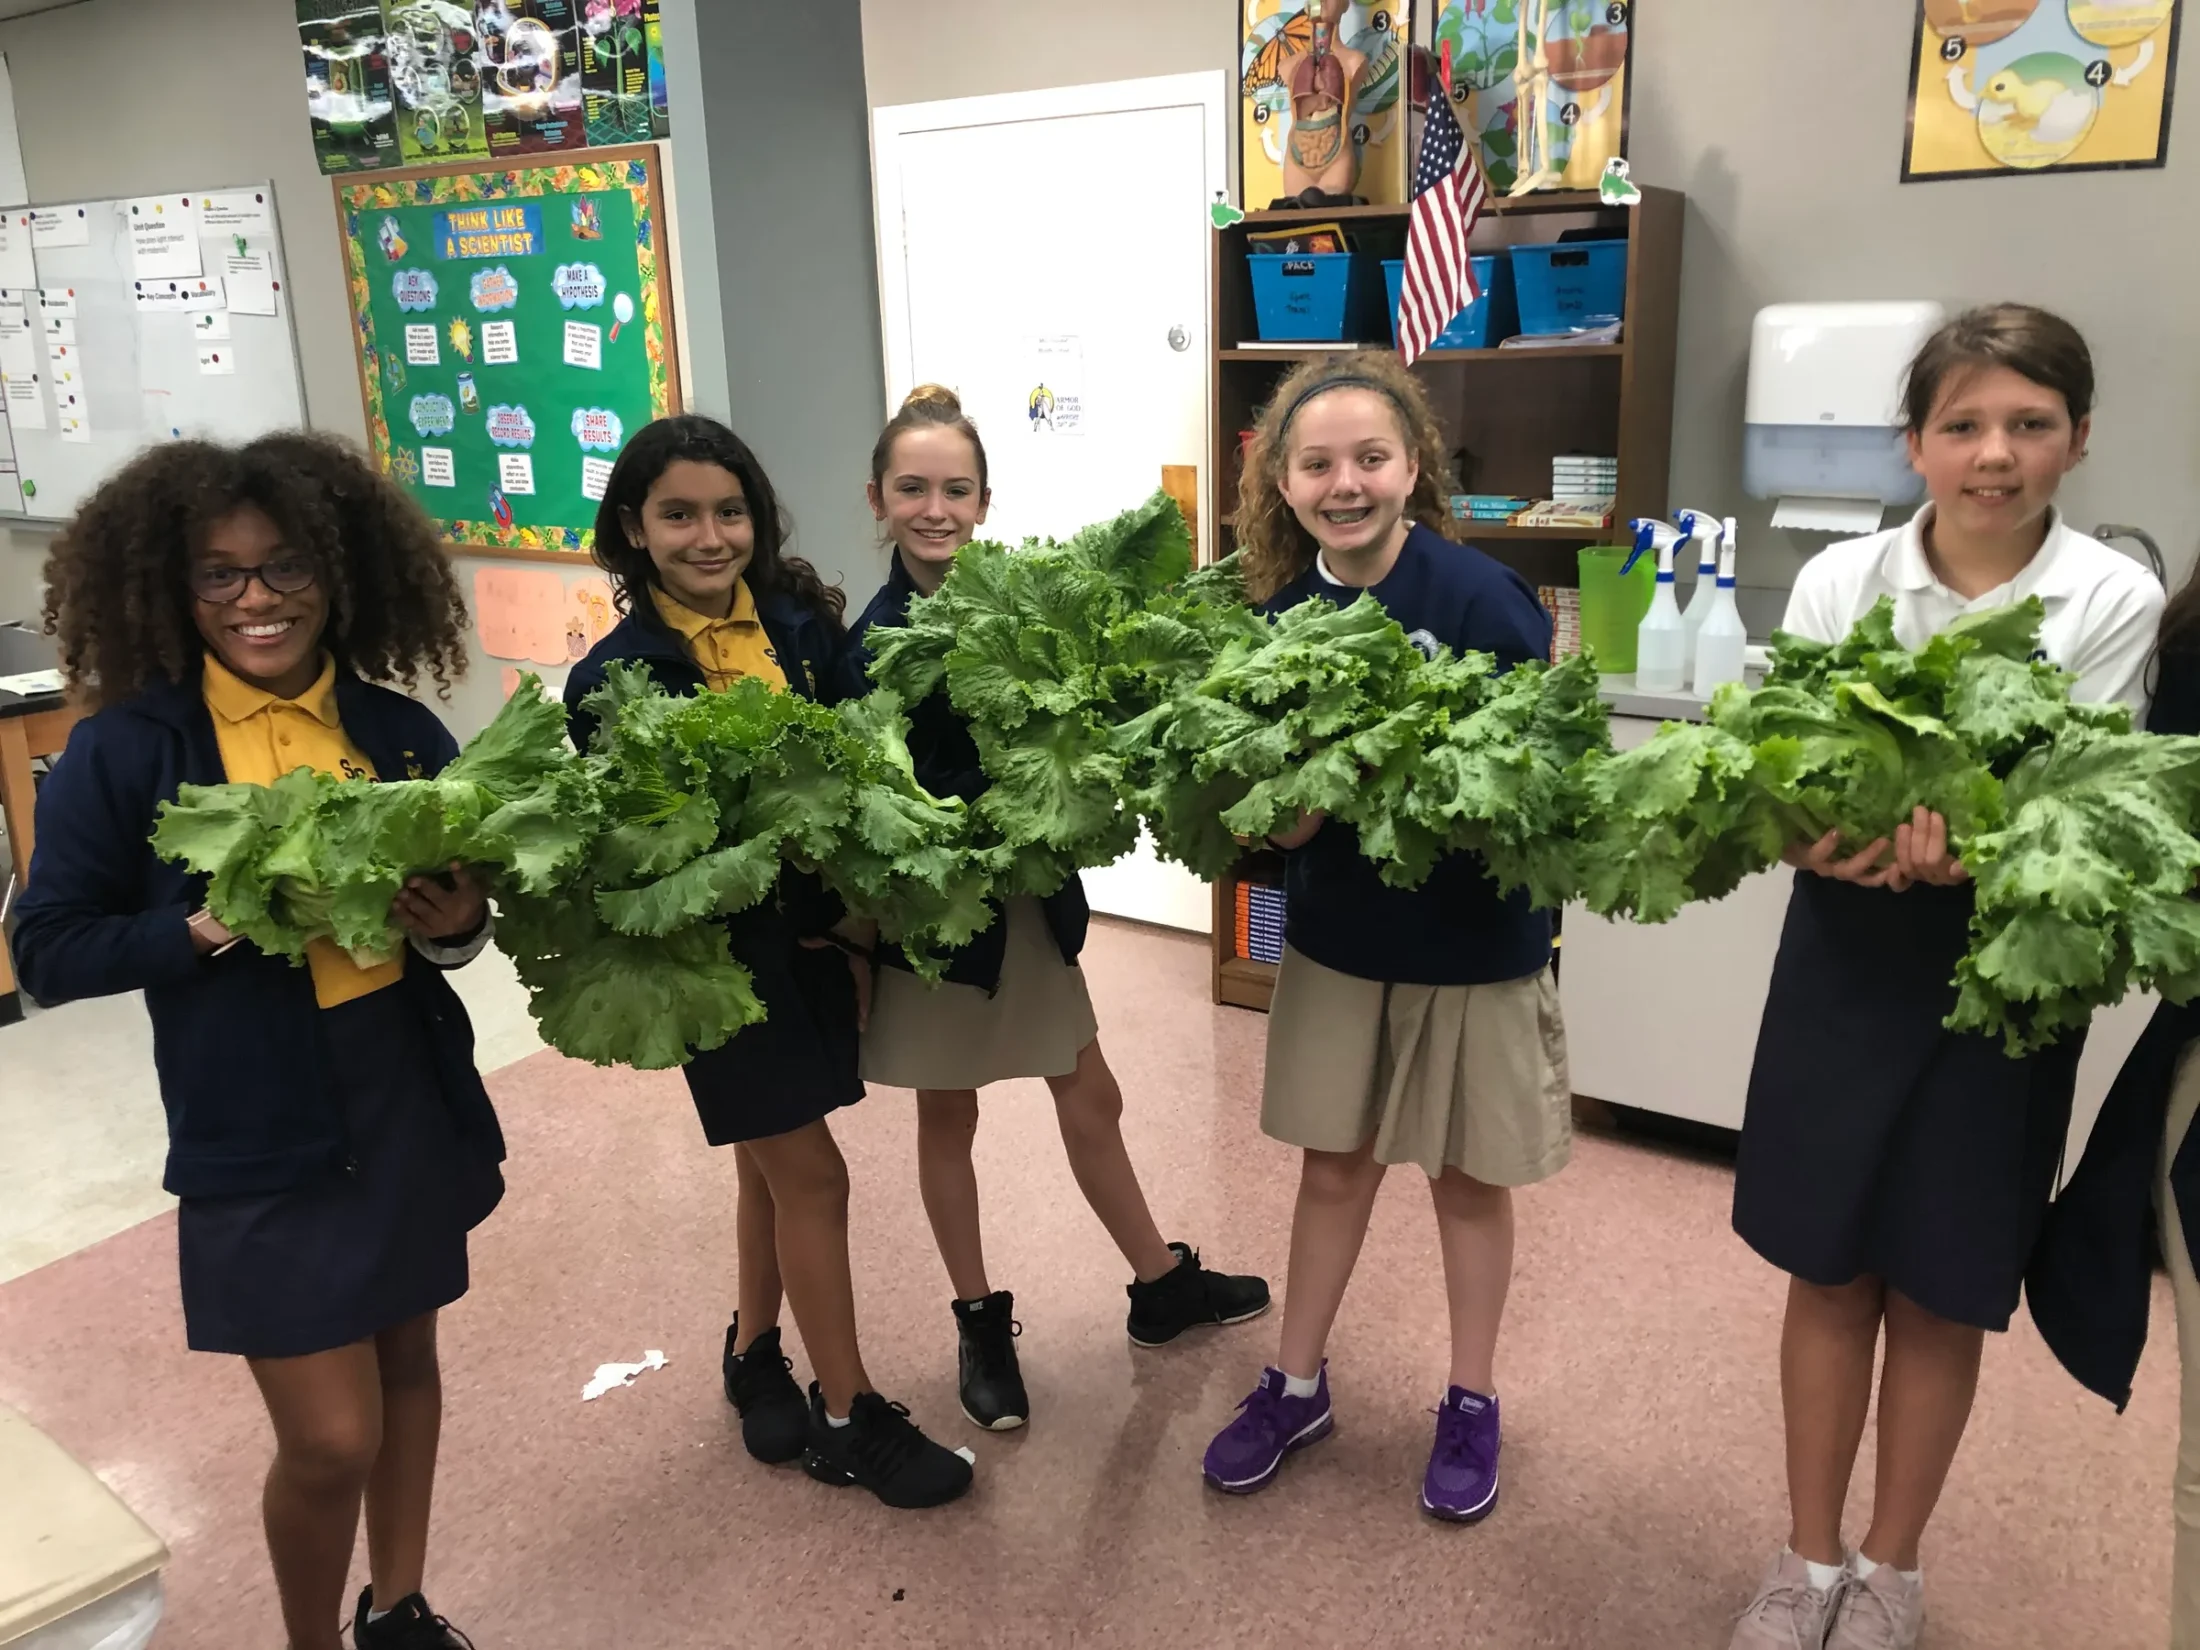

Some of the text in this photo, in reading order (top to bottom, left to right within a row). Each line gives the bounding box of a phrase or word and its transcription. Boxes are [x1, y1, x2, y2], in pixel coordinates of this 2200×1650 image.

[1374, 13, 1387, 29] 3
[1612, 4, 1623, 24] 3
[1945, 38, 1961, 60] 5
[2087, 63, 2105, 84] 4
[1454, 82, 1466, 99] 5
[1256, 105, 1268, 123] 5
[1565, 104, 1577, 124] 4
[1354, 127, 1366, 144] 4
[133, 221, 165, 231] Unit Question
[448, 208, 526, 231] THINK LIKE
[447, 232, 533, 257] A SCIENTIST
[567, 270, 588, 281] MAKE A
[156, 291, 176, 299] Concepts
[400, 290, 431, 302] QUESTIONS
[562, 285, 599, 298] HYPOTHESIS
[586, 414, 607, 427] SHARE
[511, 427, 531, 440] RESULTS
[583, 429, 611, 443] RESULTS
